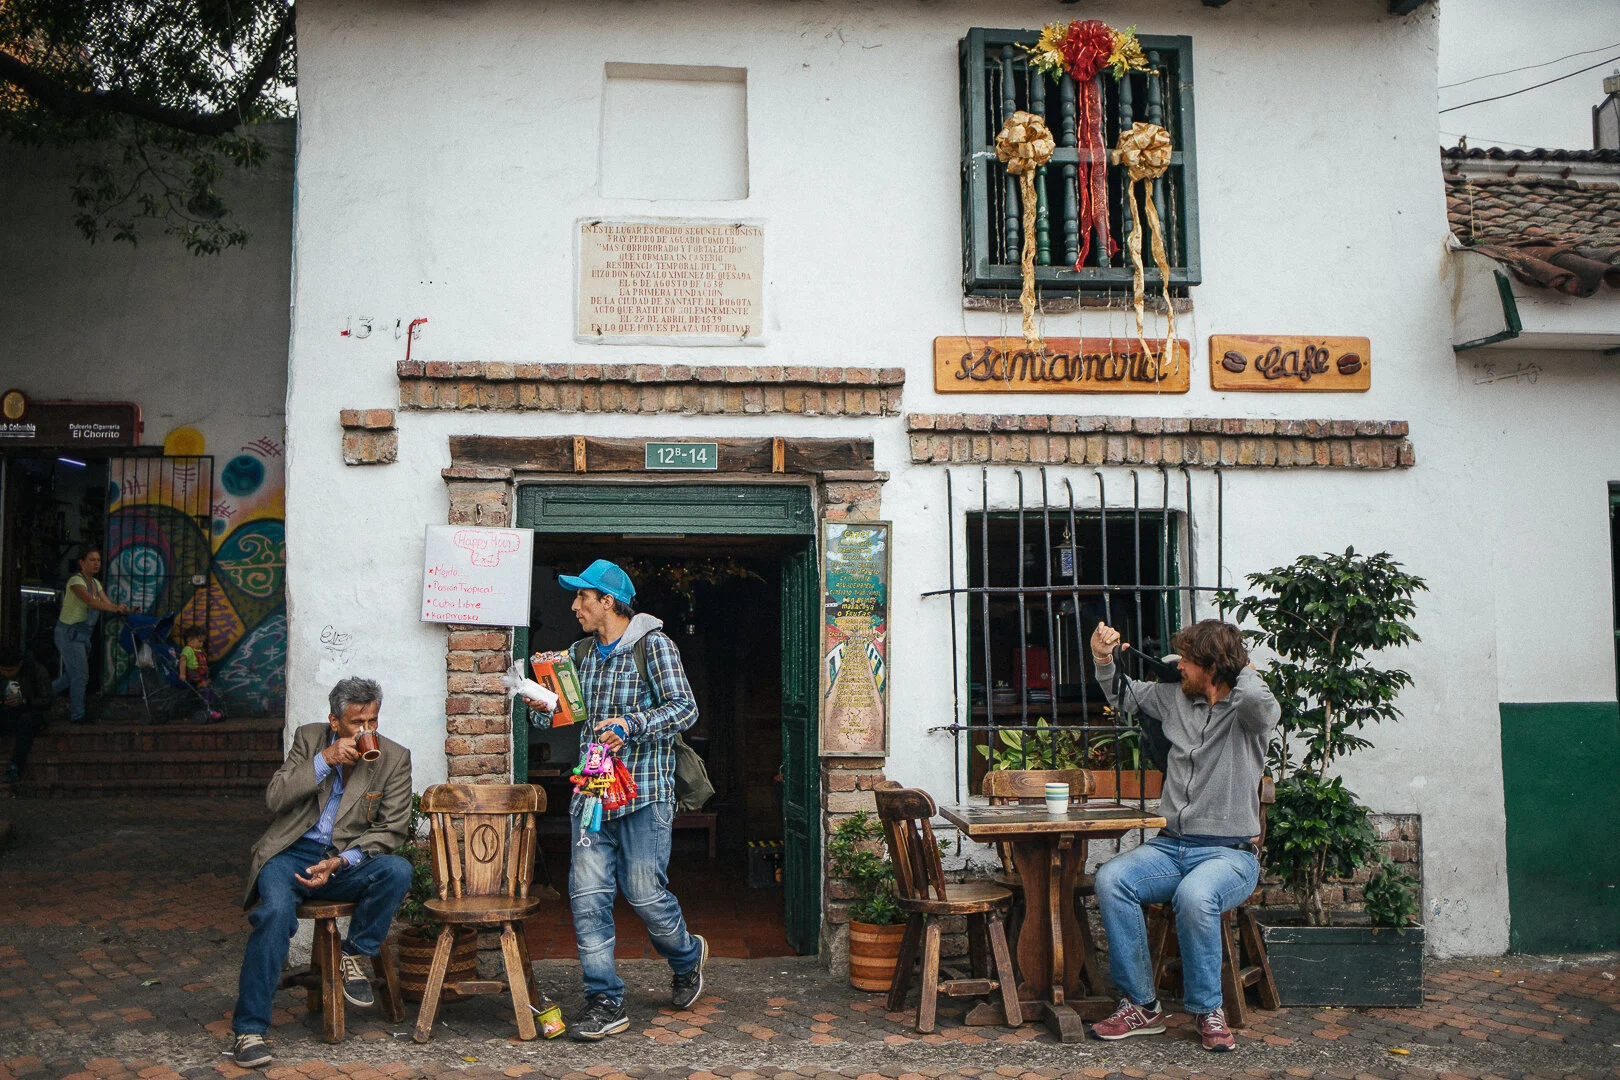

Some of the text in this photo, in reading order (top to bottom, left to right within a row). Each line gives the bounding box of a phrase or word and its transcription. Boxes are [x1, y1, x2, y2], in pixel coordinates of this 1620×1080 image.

[616, 226, 642, 234] LUGAR
[644, 227, 682, 235] ESCOGIDO
[725, 228, 762, 236] CRONISTA
[656, 262, 700, 270] TEMPORAL
[630, 270, 666, 278] GONZALO
[617, 306, 634, 314] QUE
[619, 324, 635, 332] QUE
[715, 325, 750, 333] BOLIVAR
[9, 423, 36, 432] Colombia
[73, 430, 120, 438] El Chorrito
[458, 533, 488, 550] Happy
[458, 582, 493, 594] Tropical
[458, 599, 481, 609] Libre
